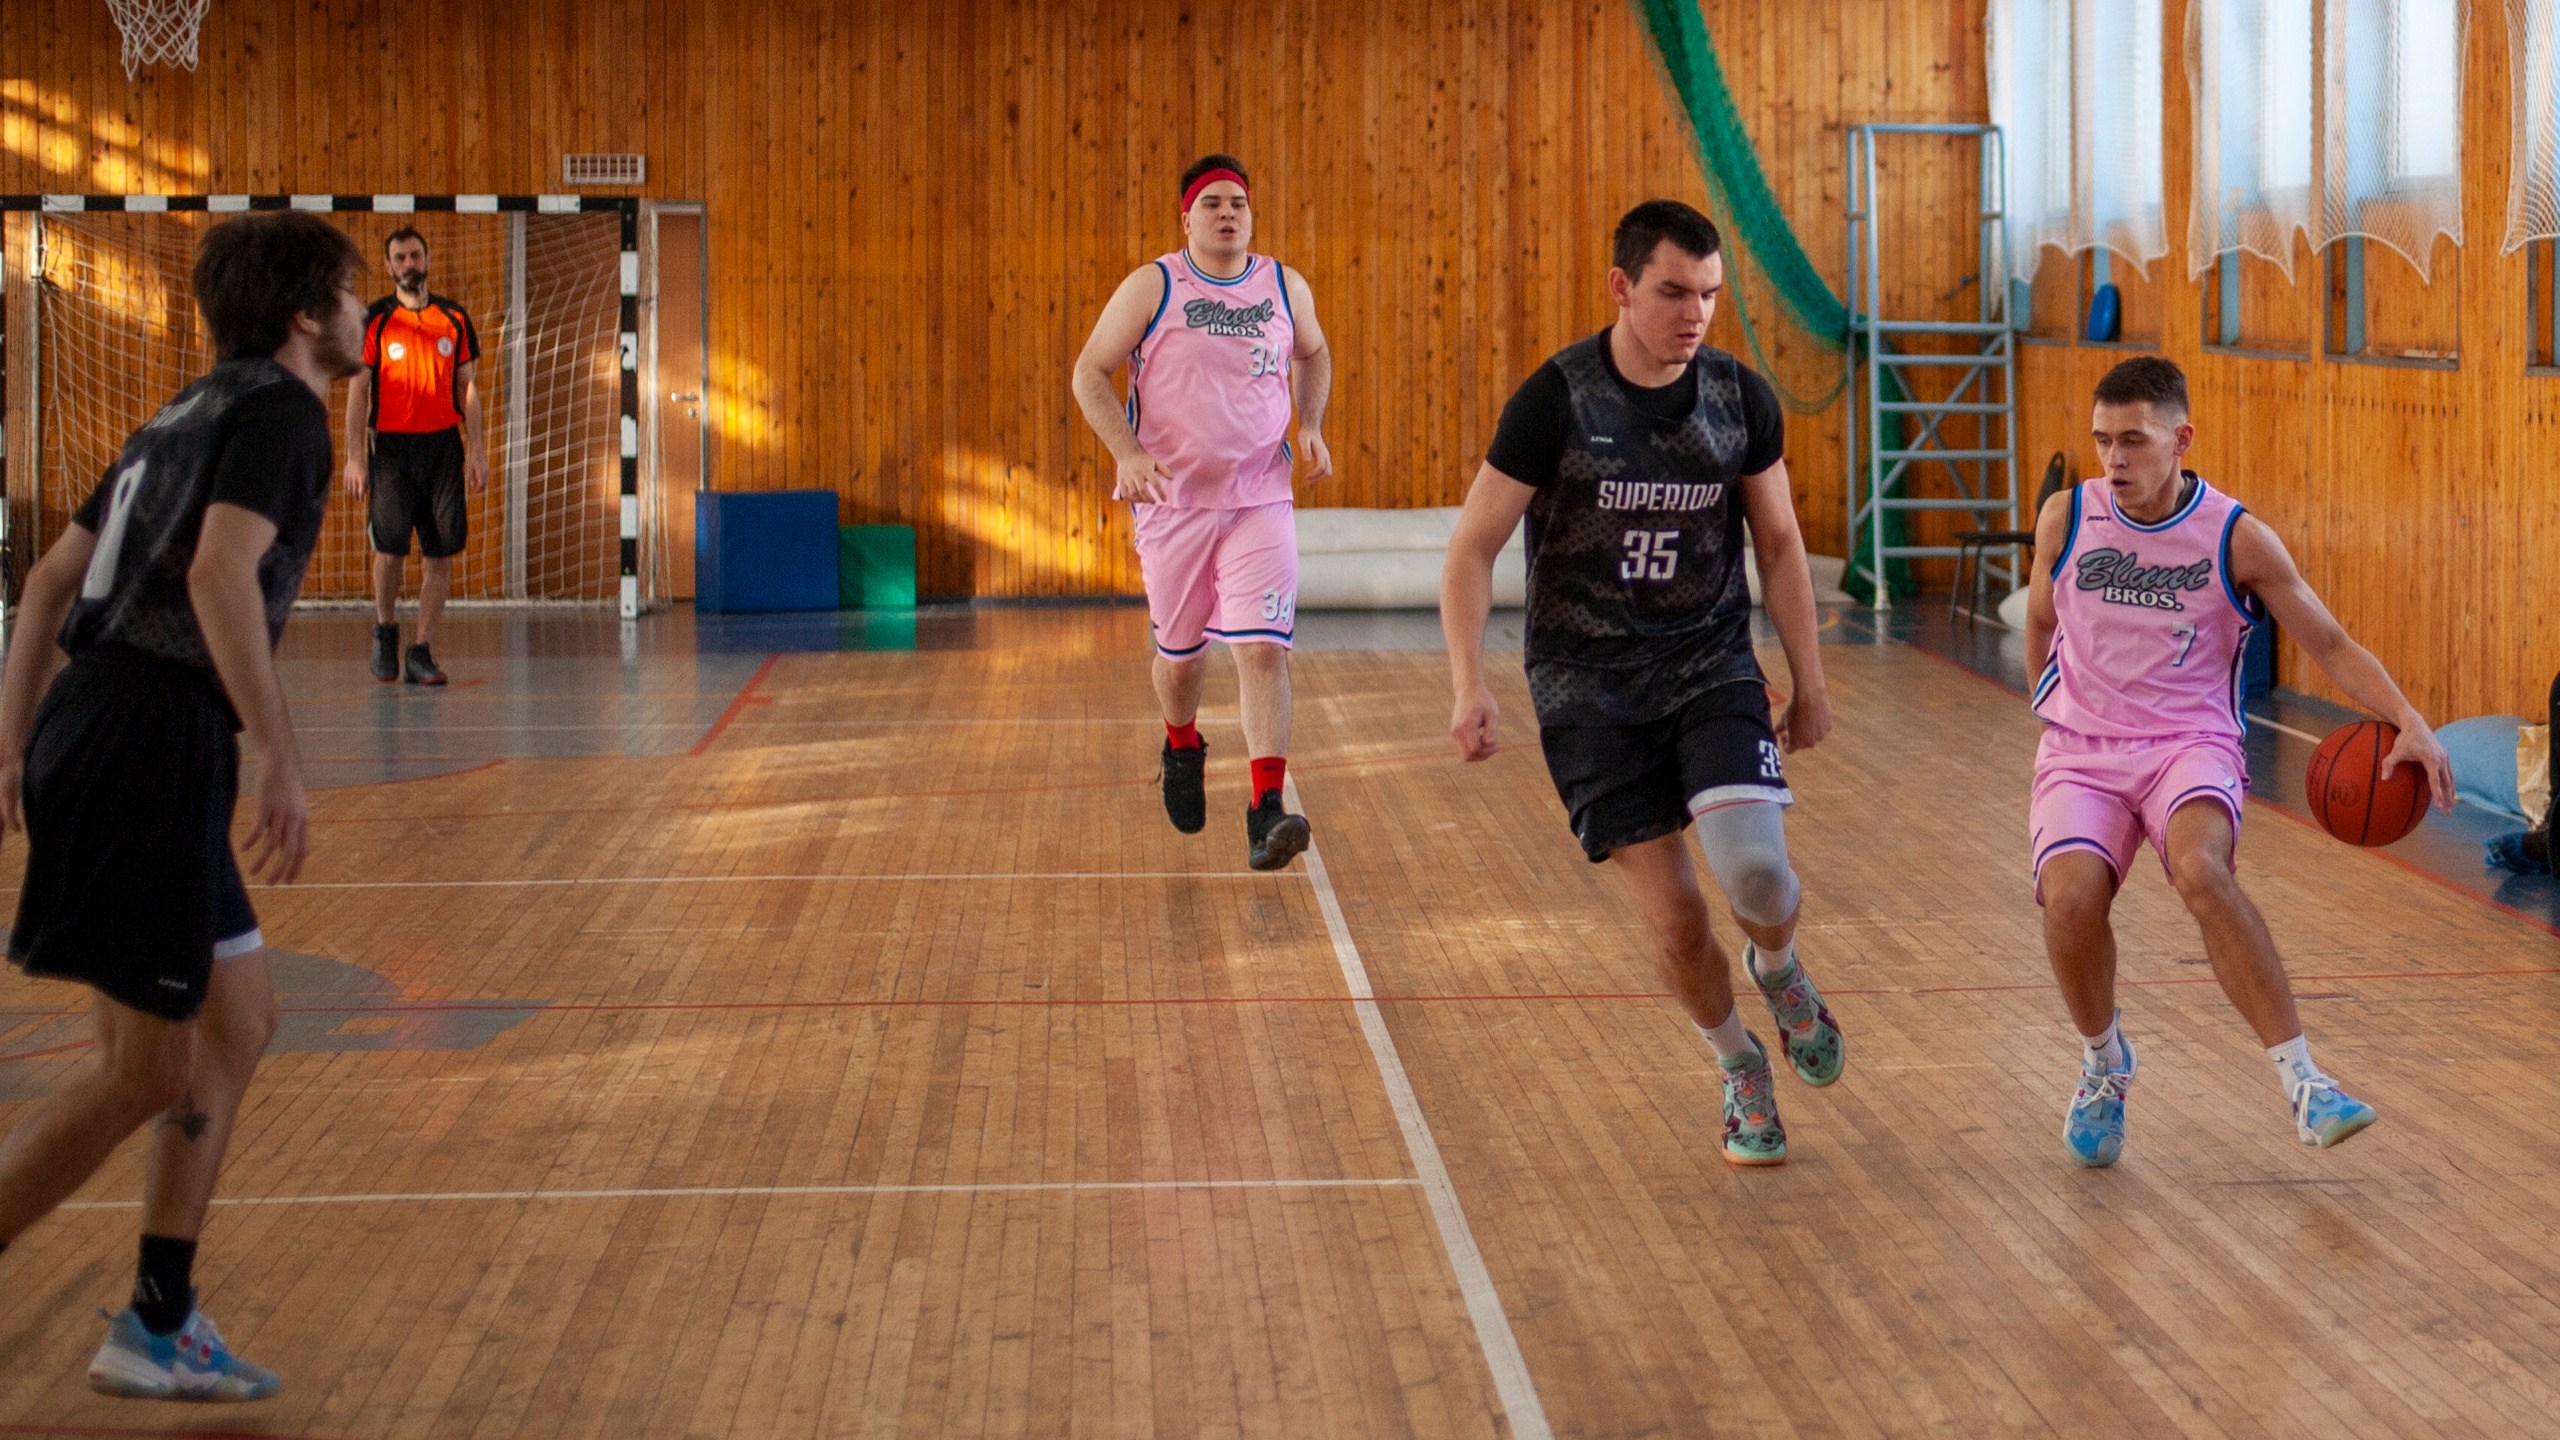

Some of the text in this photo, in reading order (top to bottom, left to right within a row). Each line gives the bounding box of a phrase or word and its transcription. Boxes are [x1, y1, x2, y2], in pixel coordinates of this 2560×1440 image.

[1184, 298, 1275, 328] Blunt
[1208, 322, 1265, 338] BROS.
[1248, 343, 1280, 377] 34
[1598, 480, 1723, 511] SUPERIOR
[1621, 530, 1680, 579] 35
[2076, 547, 2213, 591] Blunt
[1261, 588, 1294, 625] 34
[2102, 584, 2185, 611] BROS.
[2171, 621, 2197, 667] 7
